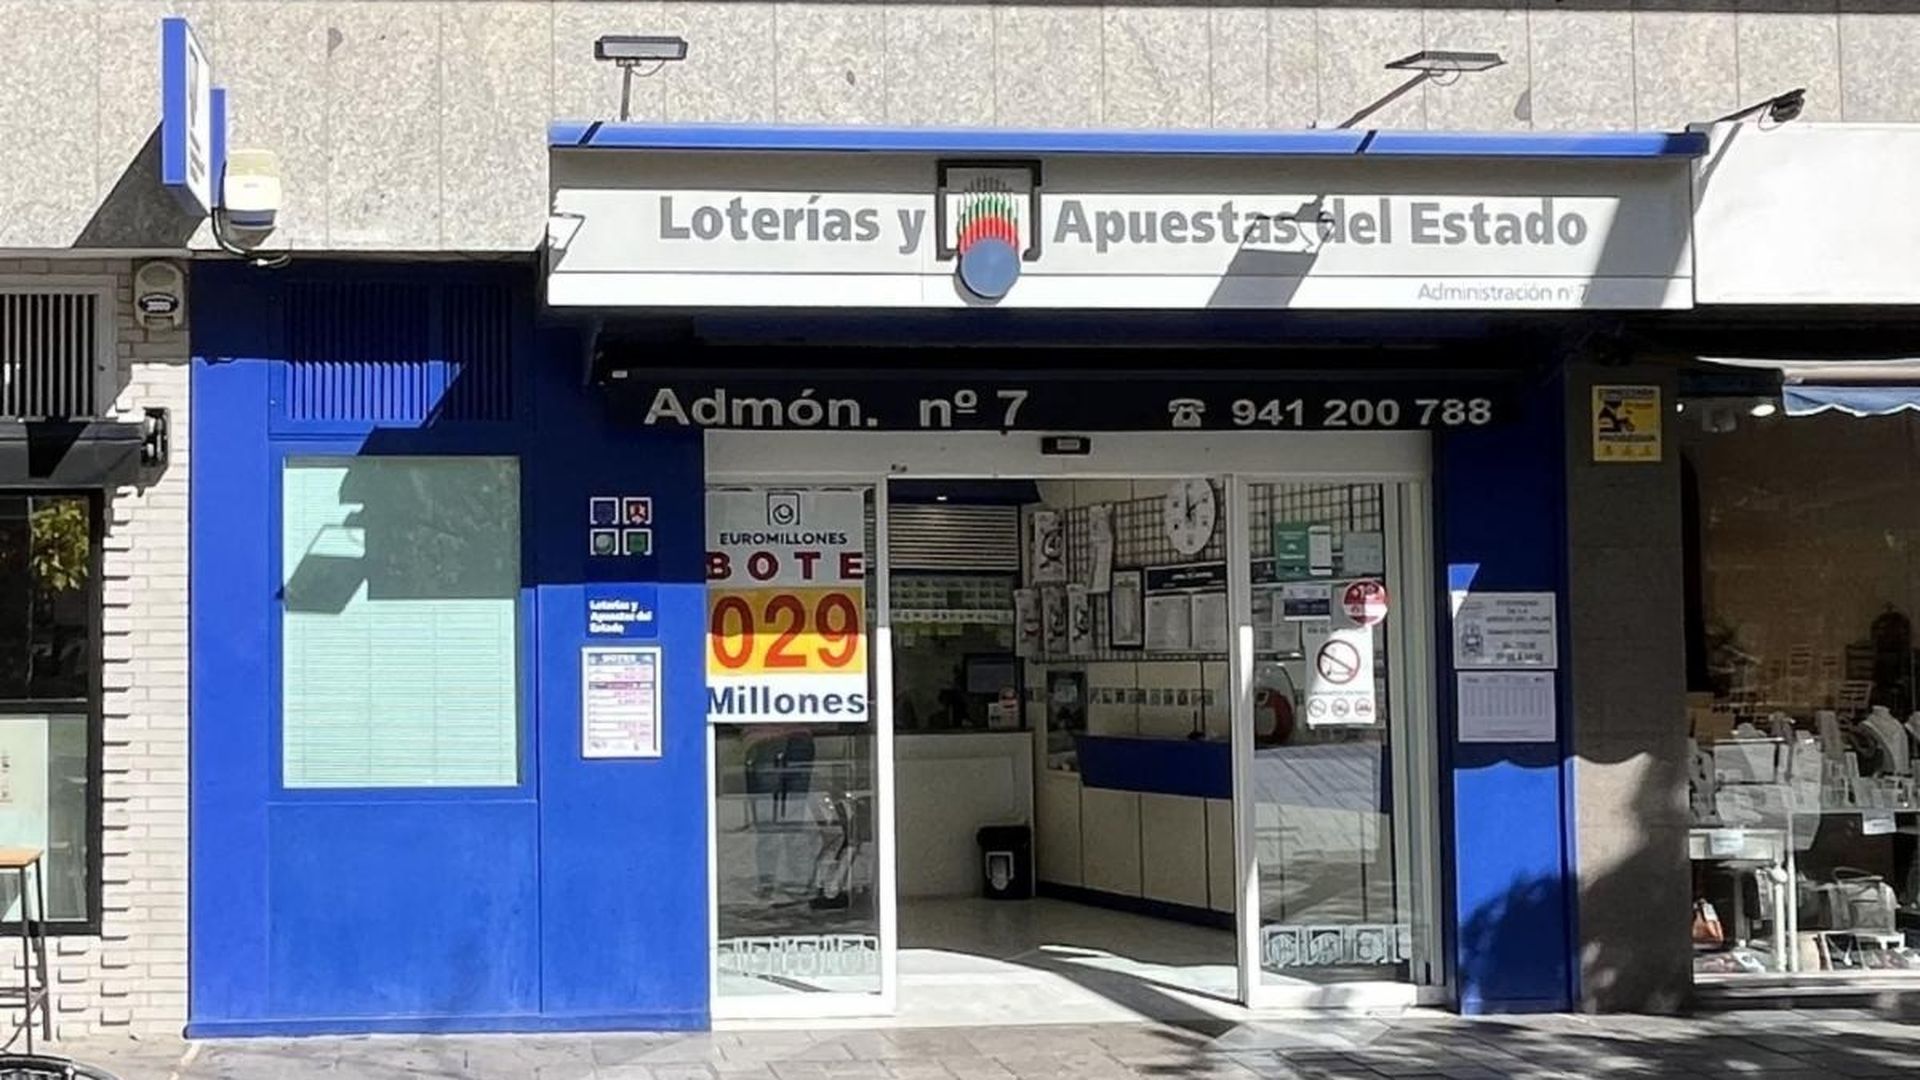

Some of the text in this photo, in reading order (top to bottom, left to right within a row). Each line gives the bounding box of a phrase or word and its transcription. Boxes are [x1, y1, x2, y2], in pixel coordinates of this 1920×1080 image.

[660, 195, 1588, 254] Loterías y Apuestas del Estado
[1417, 281, 1553, 301] Administración
[644, 388, 1491, 428] Admón. nº 7 941 200 788
[719, 532, 848, 546] EUROMILLONES
[707, 551, 865, 581] BOTE
[711, 593, 860, 670] 029
[707, 685, 866, 715] Millones
